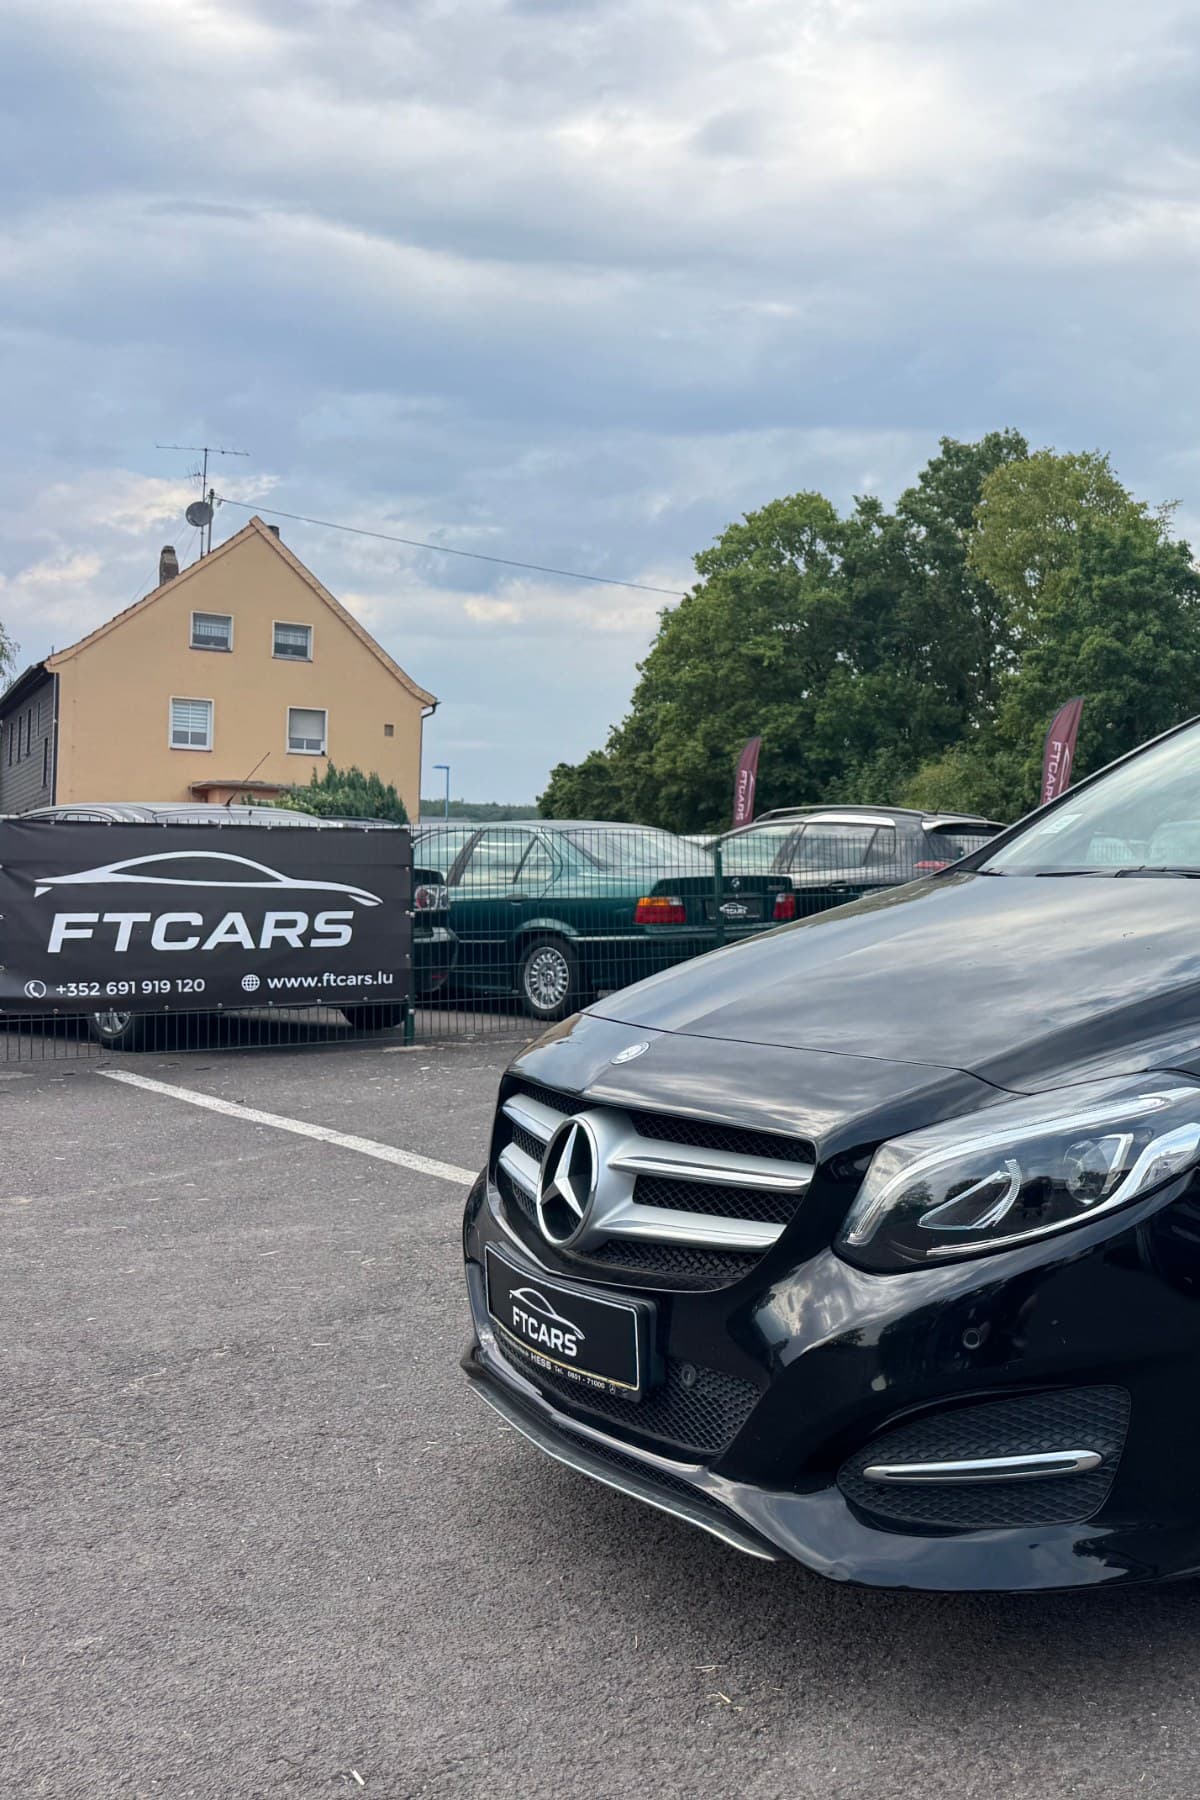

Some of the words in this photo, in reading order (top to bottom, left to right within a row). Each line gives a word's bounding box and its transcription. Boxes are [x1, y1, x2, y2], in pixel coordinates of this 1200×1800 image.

[1042, 741, 1062, 804] FTCAR
[47, 910, 355, 954] FTCARS
[55, 982, 101, 997] +352
[105, 981, 137, 995] 691
[141, 979, 171, 994] 919
[175, 978, 206, 993] 120
[267, 970, 394, 989] www.ftcars.lu
[512, 1305, 578, 1357] FTCARS
